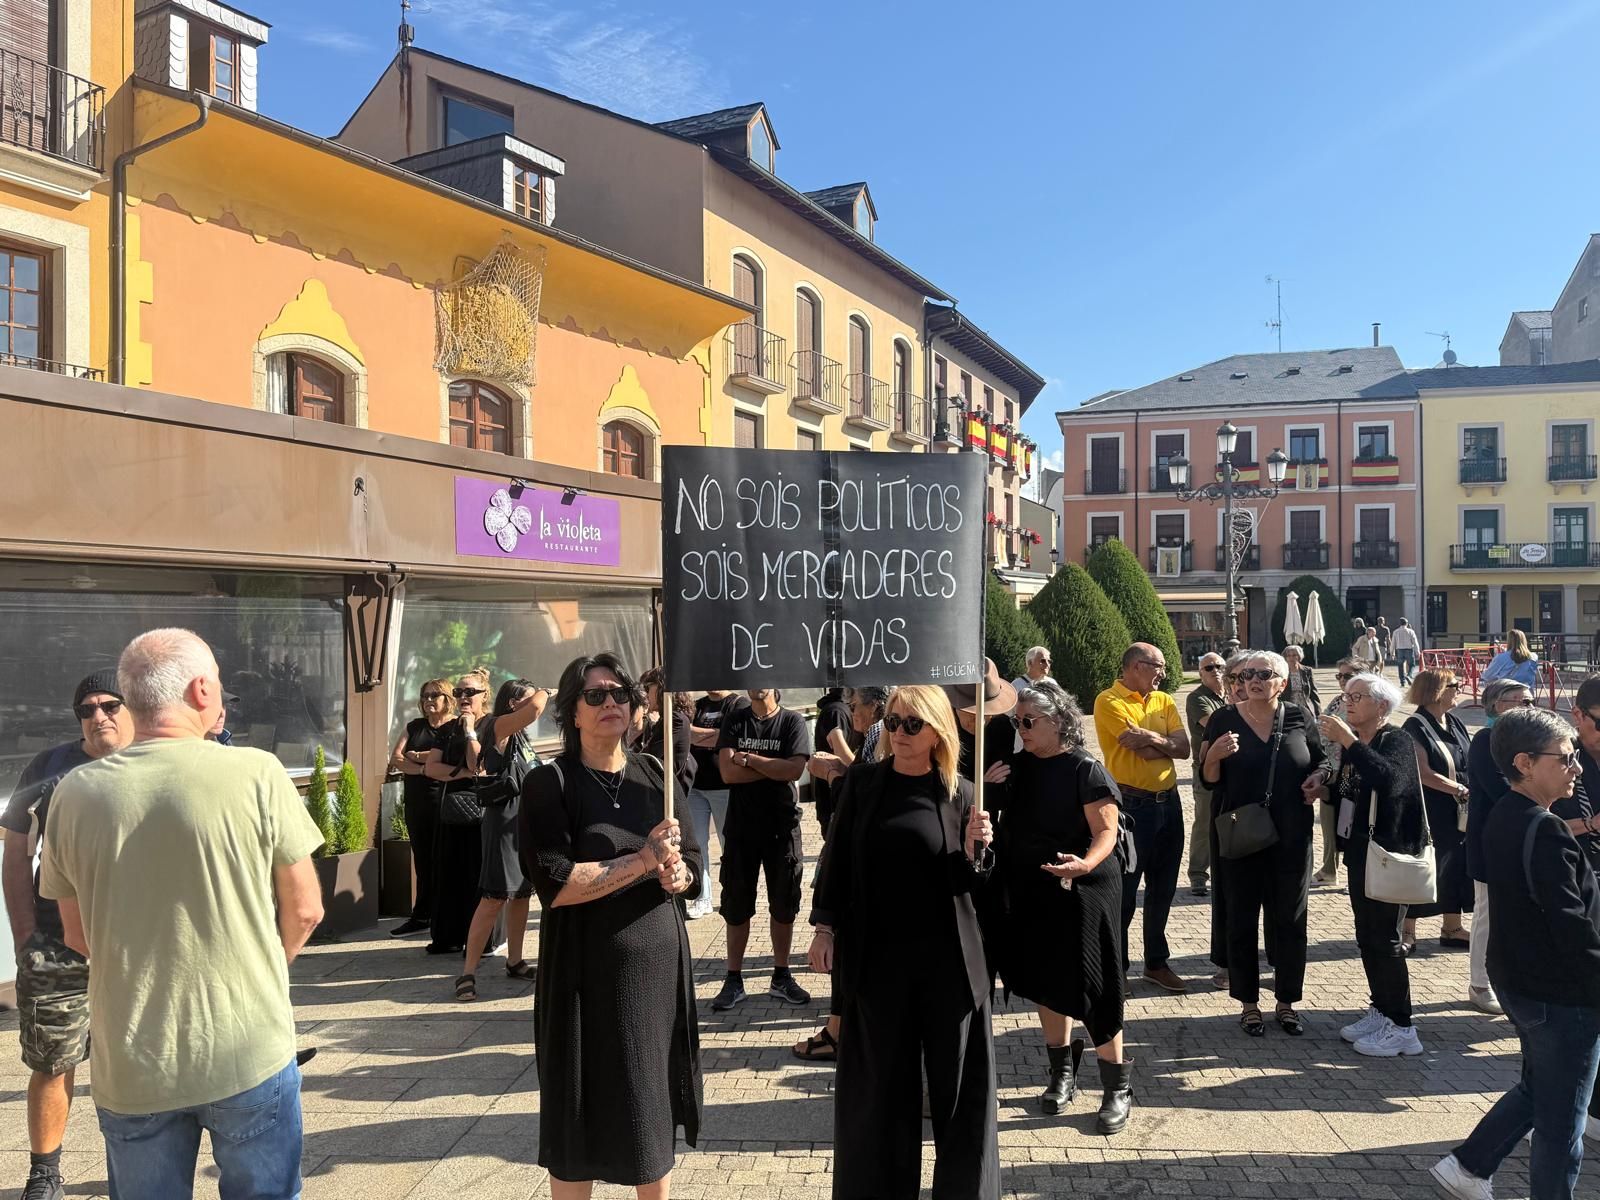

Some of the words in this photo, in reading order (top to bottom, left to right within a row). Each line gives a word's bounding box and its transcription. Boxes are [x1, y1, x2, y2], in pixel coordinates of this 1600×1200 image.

[539, 503, 552, 540] la
[557, 507, 602, 544] violeta
[674, 474, 724, 534] NO
[544, 542, 598, 553] RESTAURANTE
[758, 549, 957, 601] MERCADERES
[731, 623, 774, 671] DE
